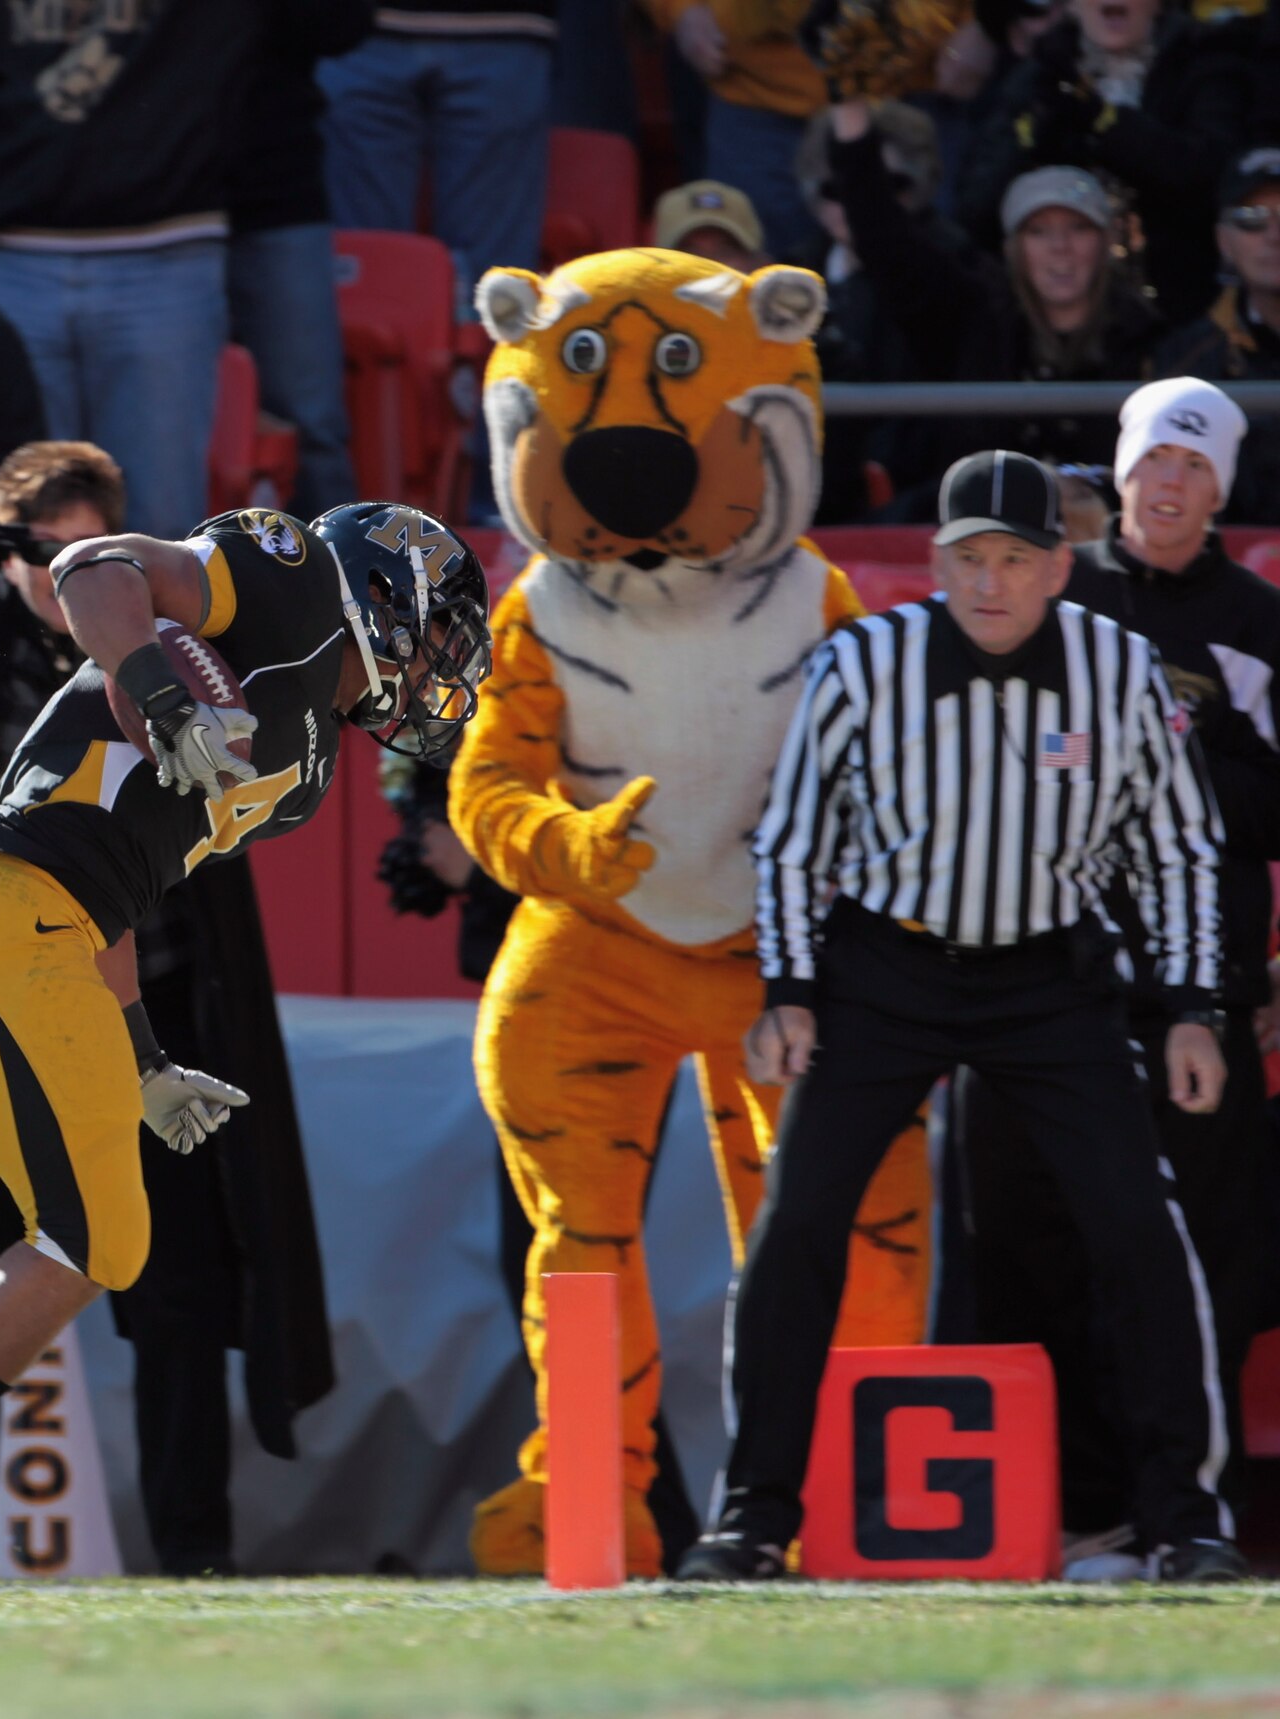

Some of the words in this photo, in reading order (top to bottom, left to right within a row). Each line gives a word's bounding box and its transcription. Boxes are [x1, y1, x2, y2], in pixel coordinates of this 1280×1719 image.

[304, 707, 318, 784] MIZZOU
[6, 1346, 72, 1577] CON
[853, 1375, 995, 1560] G
